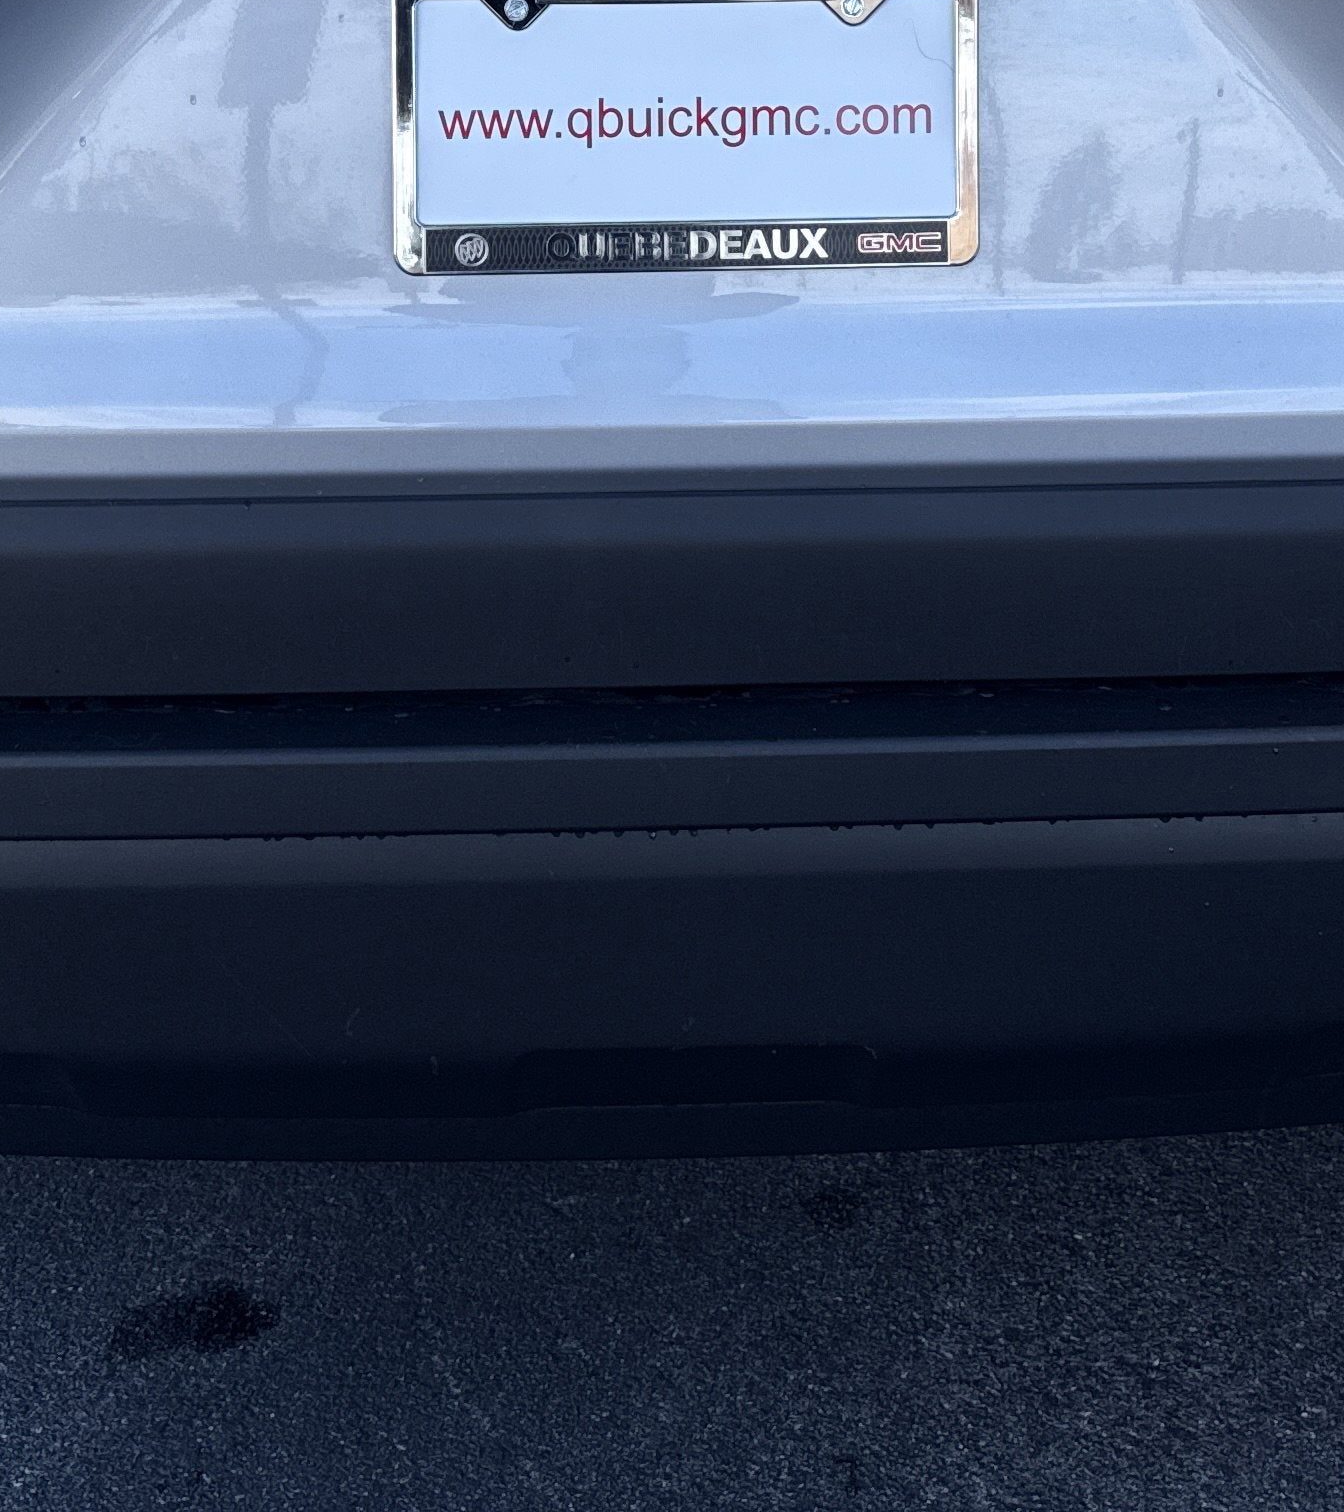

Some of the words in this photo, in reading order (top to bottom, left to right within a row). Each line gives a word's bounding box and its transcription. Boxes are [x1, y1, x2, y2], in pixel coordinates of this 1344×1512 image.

[438, 96, 933, 149] www.qbuickgmc.com
[545, 227, 829, 262] QUEBEDEAUX
[858, 232, 942, 253] GMC
